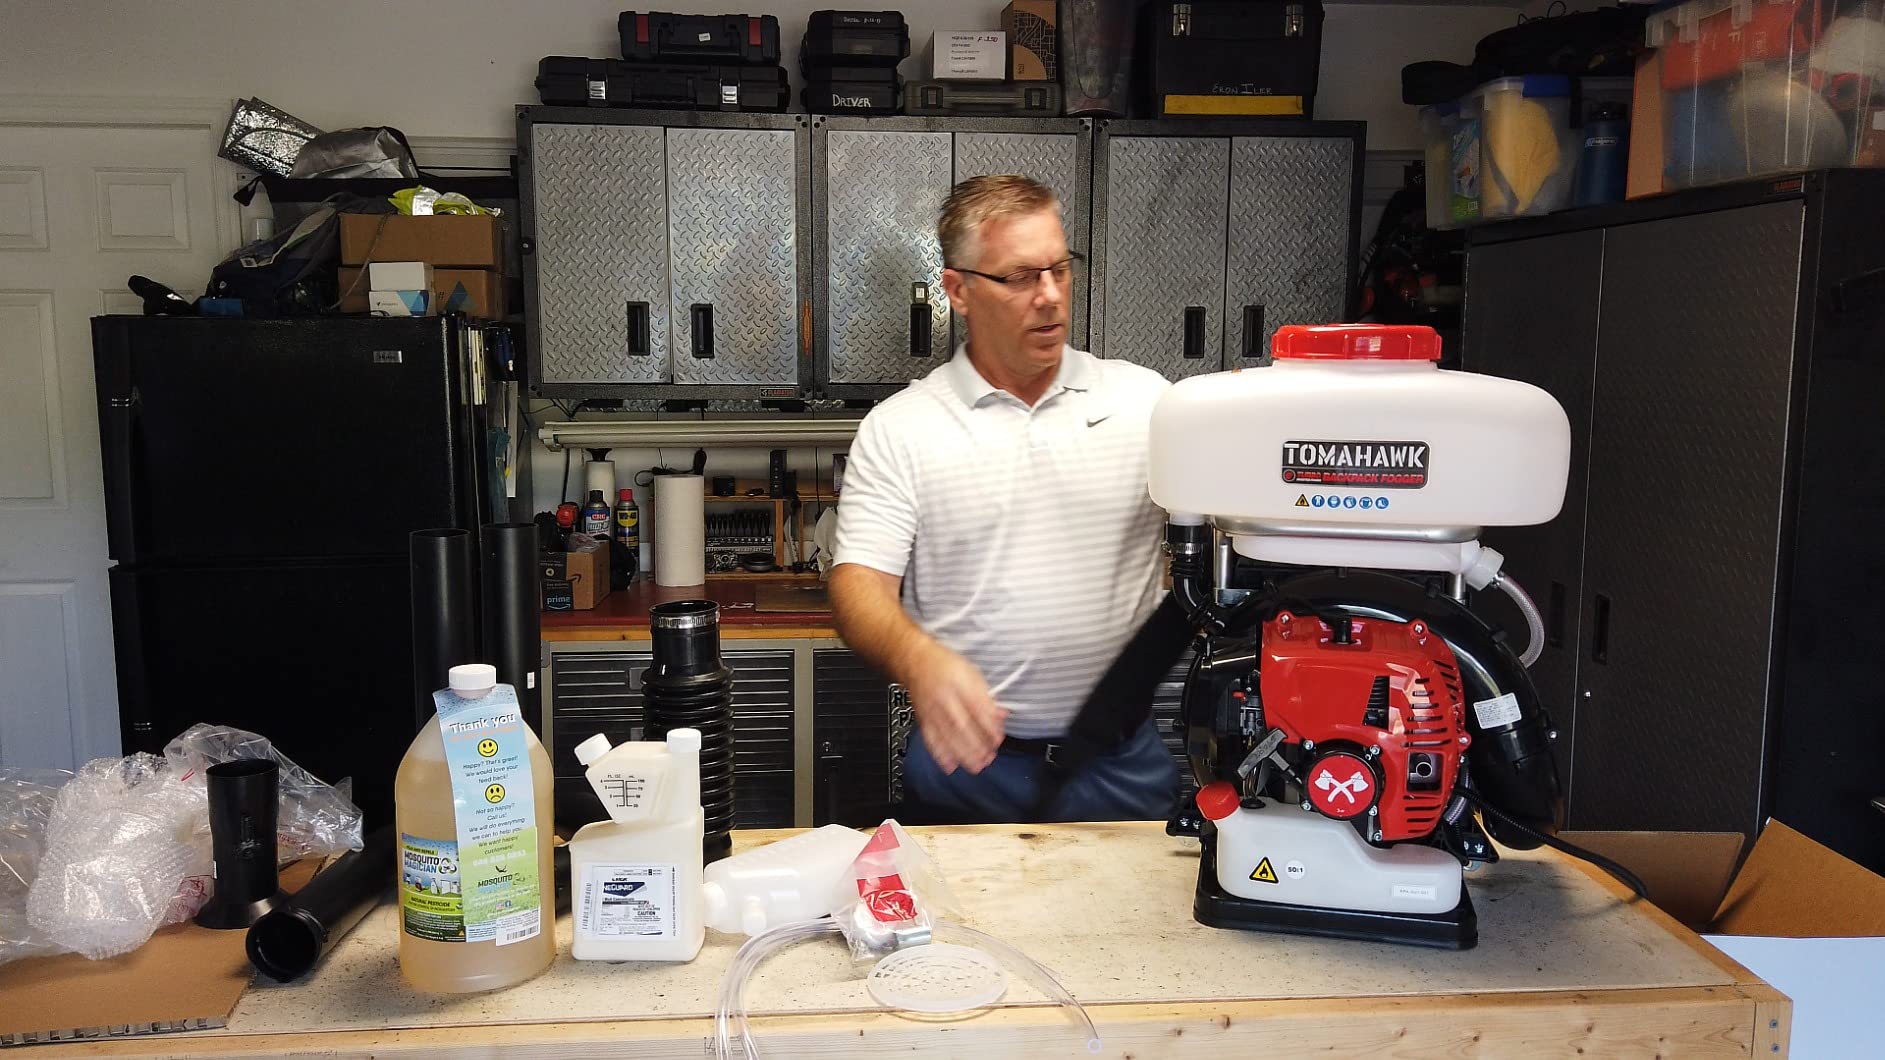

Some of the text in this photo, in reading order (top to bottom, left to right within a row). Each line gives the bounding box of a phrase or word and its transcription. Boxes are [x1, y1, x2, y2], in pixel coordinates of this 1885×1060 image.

[832, 94, 871, 107] DRIVER
[1284, 443, 1426, 468] TOMAHAWK
[1322, 472, 1379, 483] BACKPACK
[1380, 473, 1425, 484] FOGGER
[547, 595, 570, 604] prime
[449, 717, 489, 734] Thank
[491, 714, 516, 728] you
[404, 850, 439, 866] MOSQUITO
[478, 874, 513, 888] MOSQUITO
